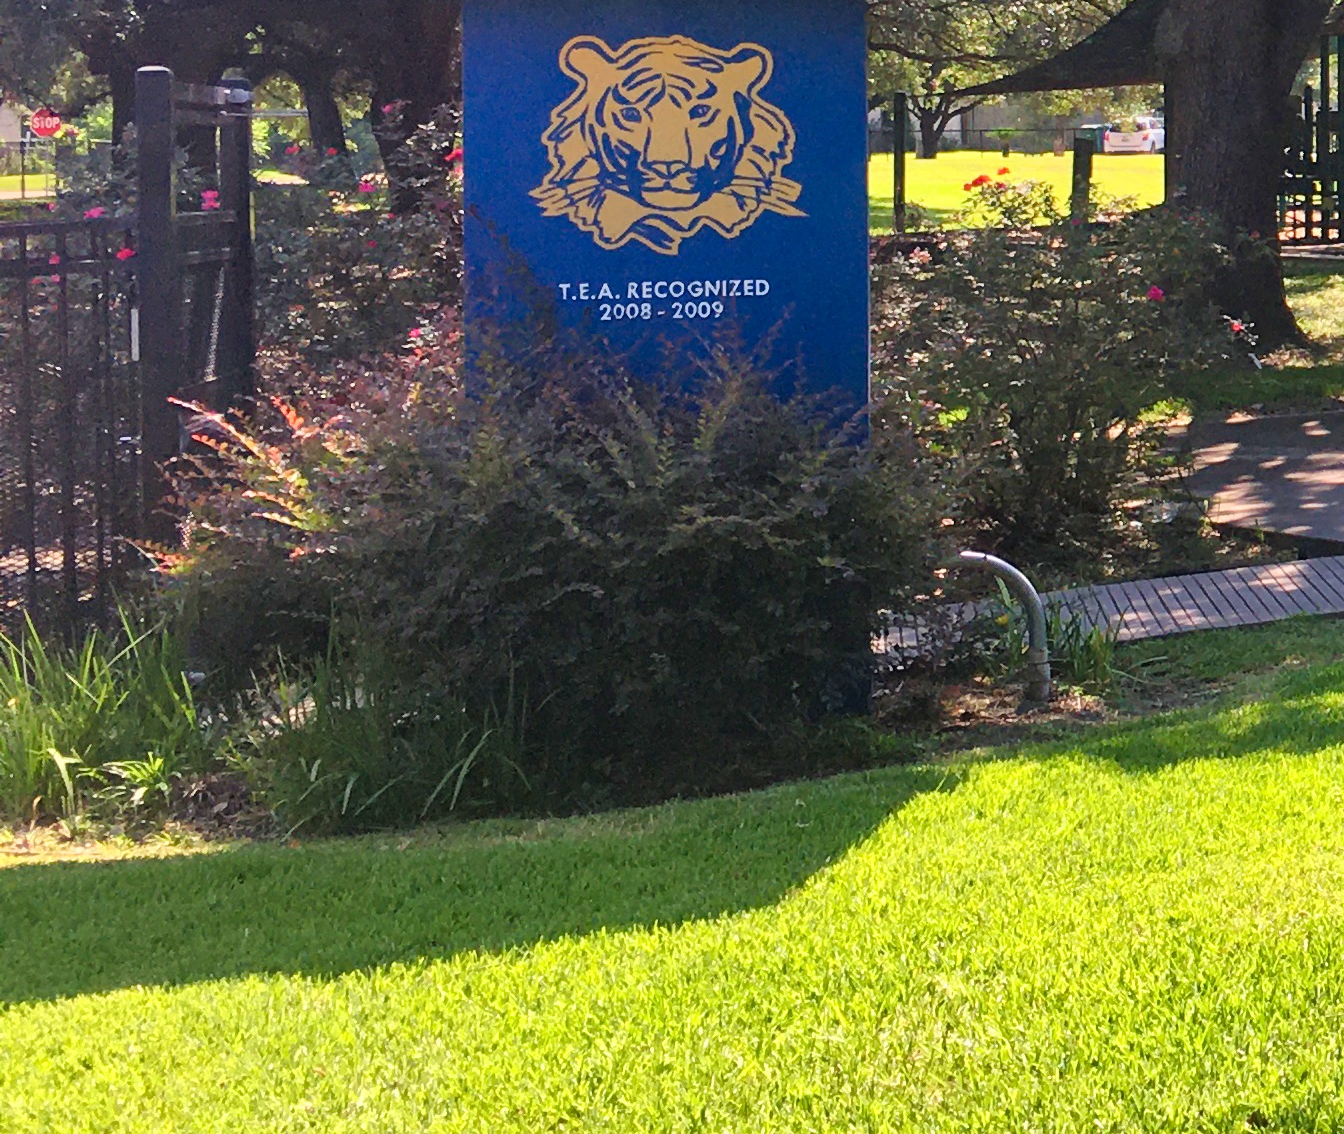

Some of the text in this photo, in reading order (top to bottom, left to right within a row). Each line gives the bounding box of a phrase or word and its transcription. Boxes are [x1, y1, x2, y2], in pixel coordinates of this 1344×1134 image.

[33, 116, 60, 129] STOP
[558, 279, 770, 300] T.E.A. RECOGNIZED
[599, 302, 652, 321] 2008
[671, 301, 724, 319] 2009
